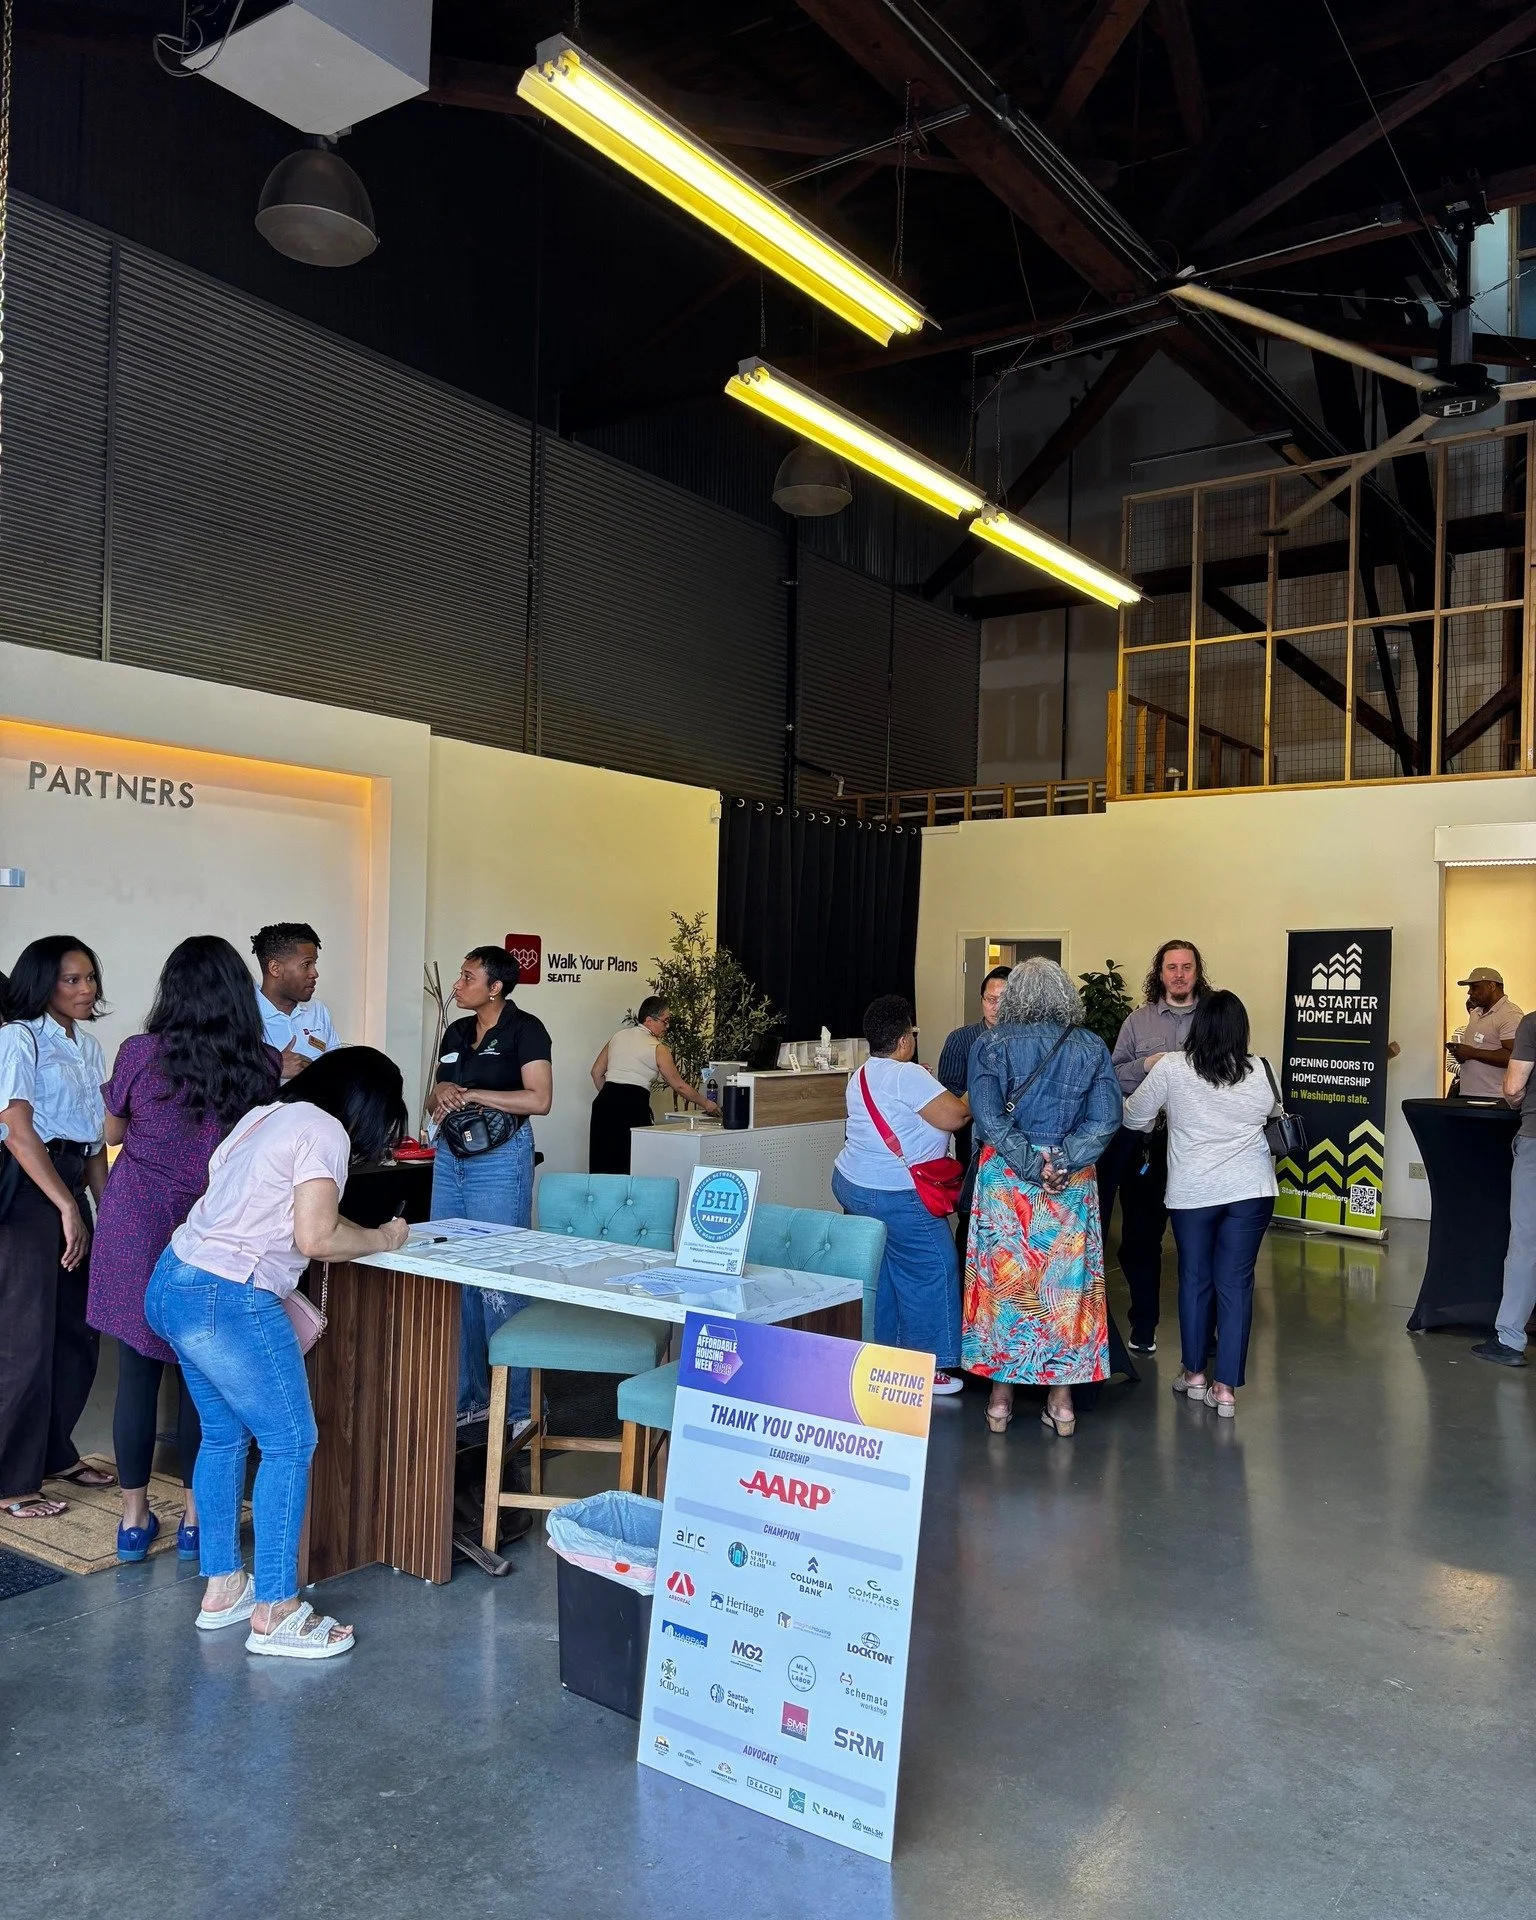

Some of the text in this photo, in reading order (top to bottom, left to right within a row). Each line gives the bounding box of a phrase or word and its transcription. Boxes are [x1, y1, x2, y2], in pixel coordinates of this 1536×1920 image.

[29, 761, 194, 808] PARTNERS
[547, 953, 638, 972] Walk Your Plans
[547, 973, 581, 983] SEATTLE
[1294, 995, 1378, 1010] WA STARTER
[1297, 1009, 1372, 1025] HOME PLAN
[1289, 1058, 1374, 1071] OPENING DOORS TO
[1292, 1073, 1371, 1087] HOMEOWNERSHIP
[1291, 1089, 1370, 1105] in Washington state.
[702, 1190, 739, 1210] BHI
[1281, 1186, 1348, 1204] StarterHomePlan.org
[702, 1214, 732, 1224] PARTNER
[697, 1336, 738, 1353] AFFORDABLE
[696, 1347, 724, 1362] HOUSING
[695, 1358, 713, 1372] WEEK
[869, 1368, 925, 1391] CHARTING
[868, 1384, 925, 1408] THE FUTURE
[711, 1404, 884, 1460] THANK YOU SPONSORS!
[769, 1448, 810, 1465] LEADERSHIP
[763, 1524, 801, 1542] CHAMPION
[790, 1573, 833, 1591] COLUMBIA
[799, 1585, 822, 1598] BANK
[848, 1587, 900, 1607] COMPASS
[726, 1596, 765, 1618] Heritage
[732, 1639, 763, 1663] MG2
[847, 1643, 893, 1665] LOCKTON
[659, 1679, 690, 1697] SCIDpda
[791, 1674, 811, 1685] LABOR
[727, 1690, 749, 1703] Seattle
[845, 1687, 888, 1707] schemata
[726, 1698, 755, 1714] City Light
[860, 1702, 887, 1716] workshop
[742, 1745, 778, 1766] ADVOCATE
[749, 1779, 779, 1796] DEACON
[823, 1807, 845, 1821] RAFN
[862, 1824, 883, 1837] WALSH
